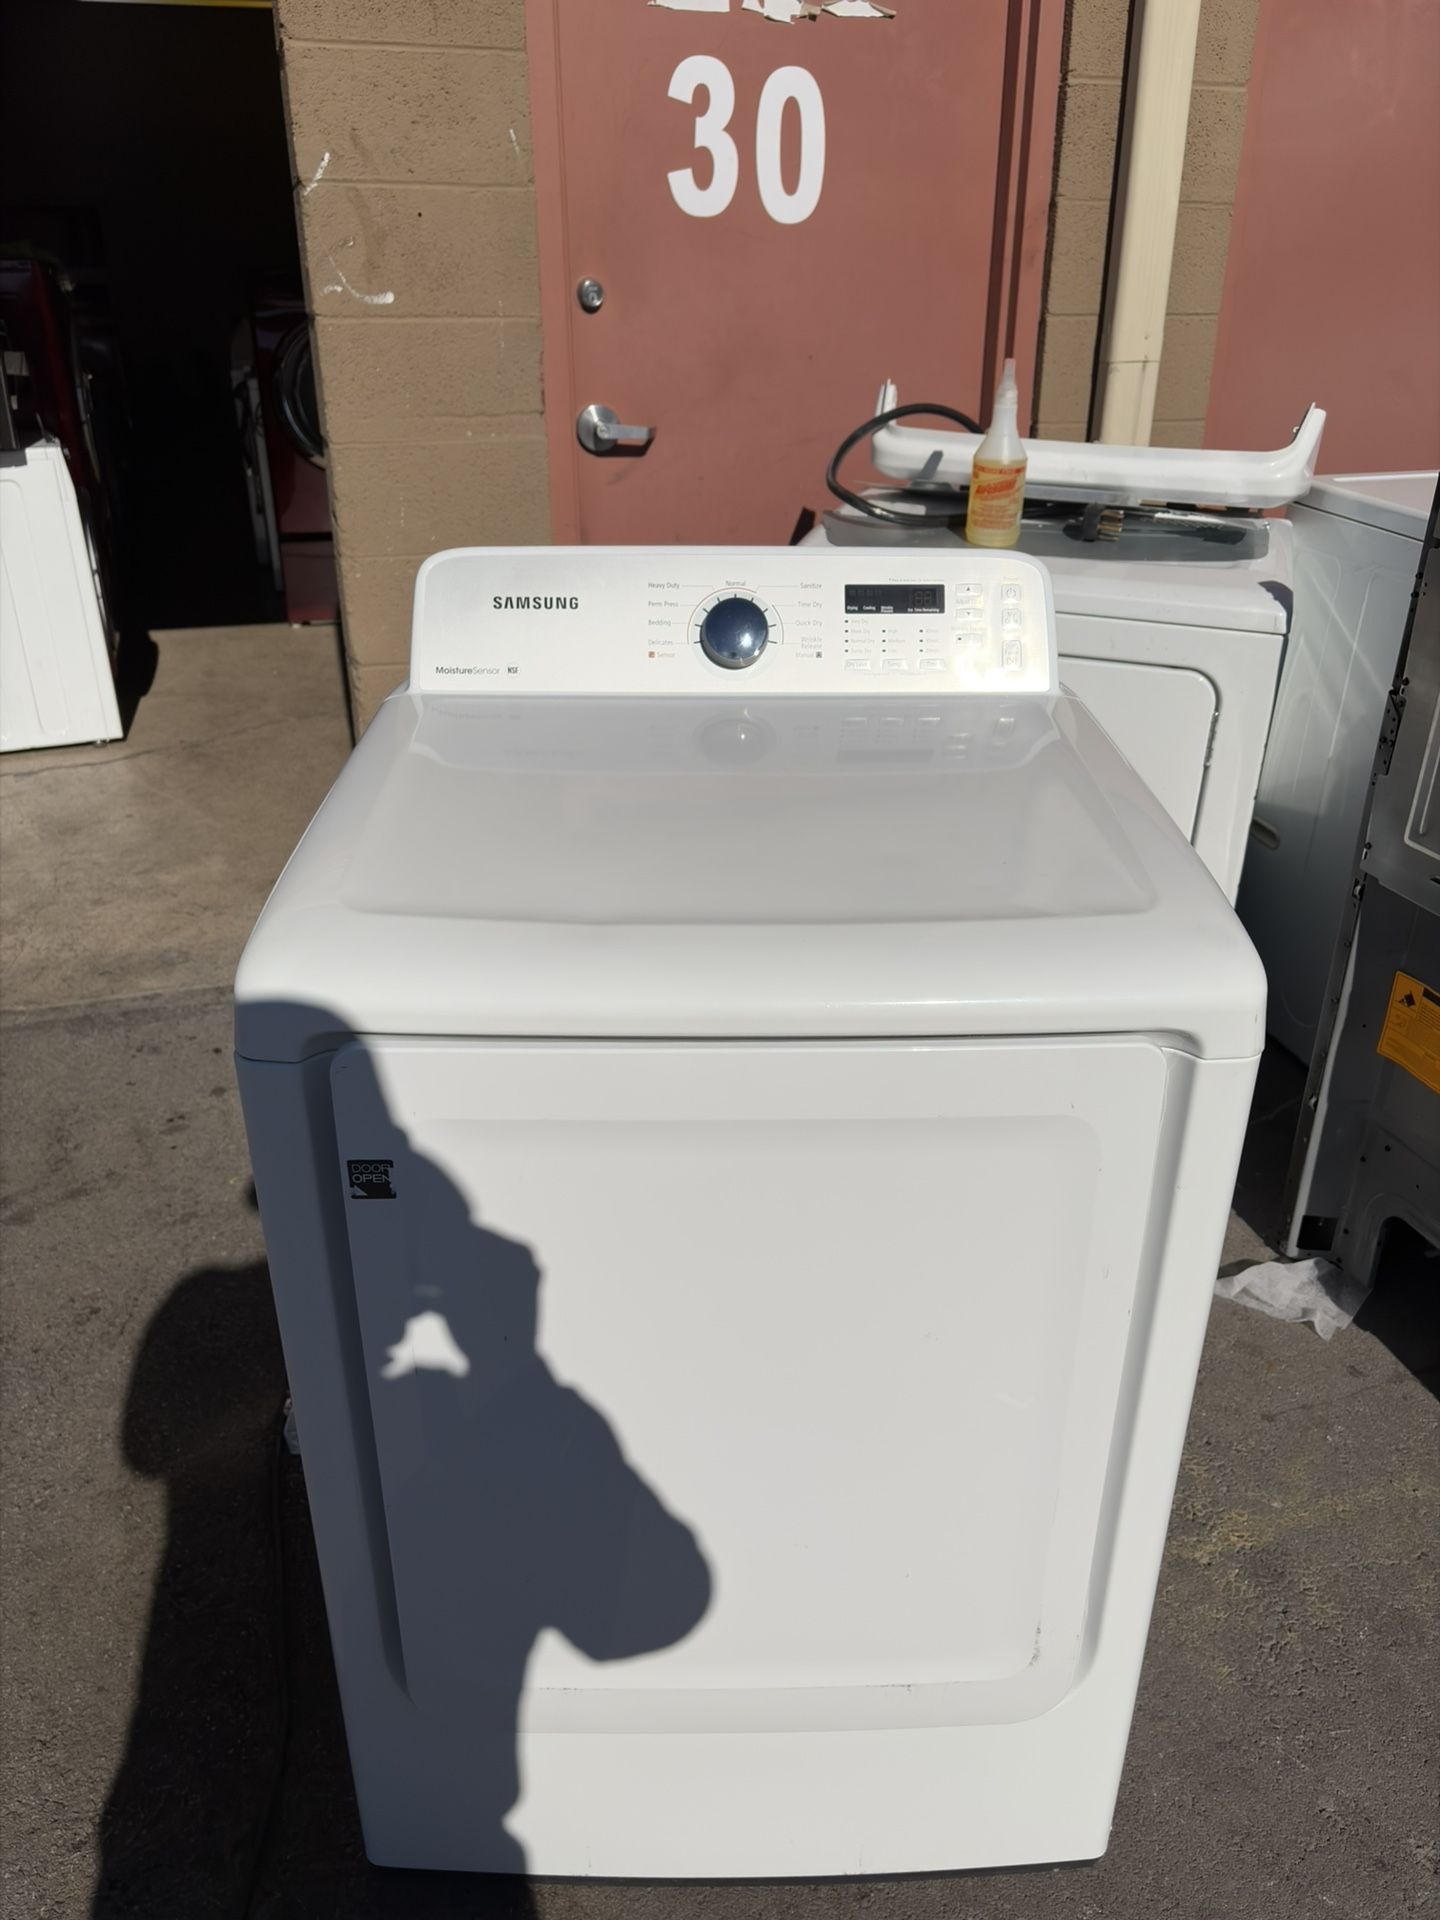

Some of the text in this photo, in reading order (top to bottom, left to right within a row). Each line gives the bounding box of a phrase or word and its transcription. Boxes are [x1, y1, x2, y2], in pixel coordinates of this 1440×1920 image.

[667, 55, 826, 224] 30
[648, 582, 680, 590] Heavy Duty
[493, 596, 579, 610] SAMSUNG
[813, 601, 822, 609] Dry
[648, 619, 671, 627] Bedding
[813, 620, 822, 628] Dry
